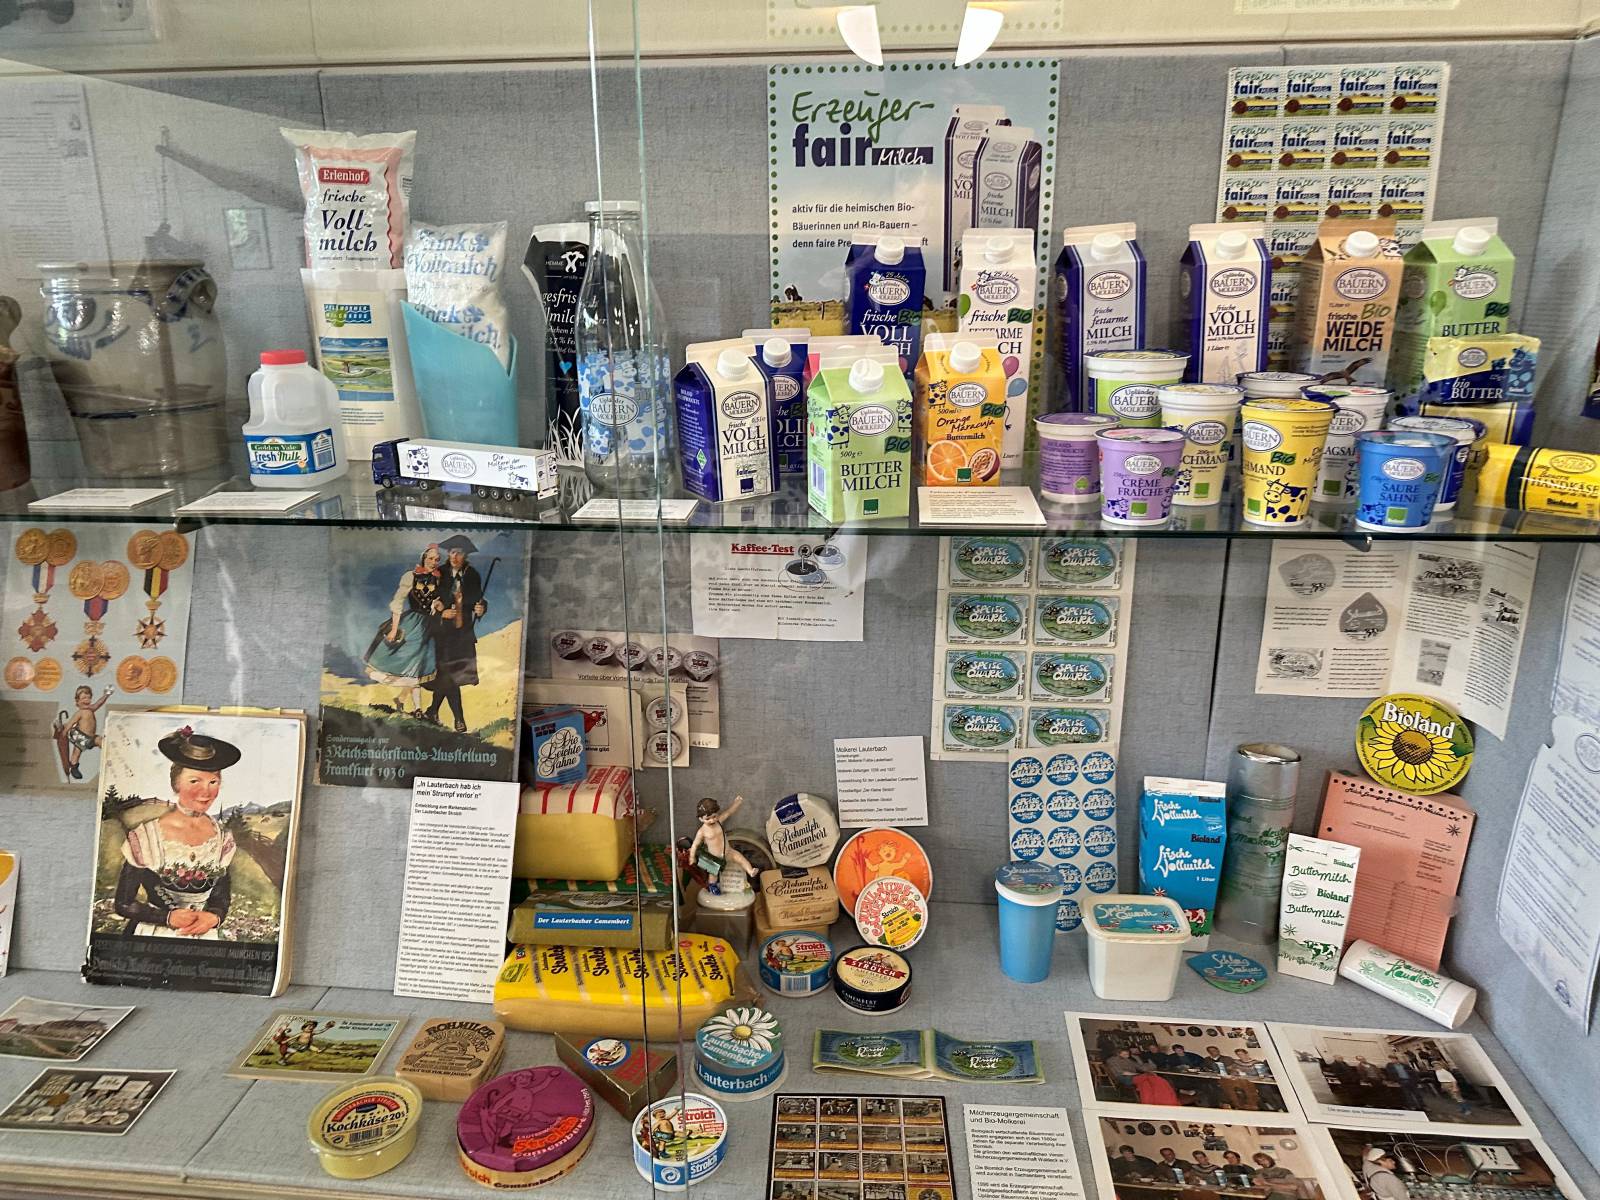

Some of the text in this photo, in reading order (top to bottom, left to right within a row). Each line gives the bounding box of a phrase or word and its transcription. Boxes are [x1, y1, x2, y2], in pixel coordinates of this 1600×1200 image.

[1234, 76, 1419, 95] fair fair fair fair
[792, 90, 935, 143] Erzeuger-
[792, 122, 926, 168] fair Milch
[323, 169, 365, 182] Erlenhof
[322, 188, 366, 205] frische
[792, 202, 915, 214] aktiv für die heimischen Bio-
[980, 207, 1014, 217] MILCH
[321, 209, 372, 230] Voll-
[792, 220, 841, 232] Bäuerinnen
[843, 220, 859, 230] und
[319, 231, 377, 252] milch
[792, 238, 835, 248] denn faire
[1090, 279, 1129, 290] BAUERN
[1213, 277, 1253, 288] BAUERN
[1339, 278, 1384, 289] BAUERN
[1455, 279, 1495, 289] BAUERN
[871, 286, 907, 296] BAUERN
[980, 286, 1015, 296] BAUERN
[1093, 306, 1113, 317] frische
[1216, 304, 1236, 313] frische
[1361, 303, 1391, 320] Bio
[862, 309, 921, 324] frische Bio
[969, 308, 1032, 325] frische Bio
[1091, 315, 1129, 328] fettarme
[1209, 310, 1255, 326] VOLL
[1328, 312, 1358, 321] frische
[860, 324, 912, 342] VOLL
[1086, 325, 1132, 341] MILCH
[1208, 323, 1255, 337] MILCH
[1326, 321, 1384, 338] WEIDE
[1441, 321, 1501, 338] BUTTER
[1322, 338, 1382, 352] MILCH
[1452, 377, 1470, 388] bio
[951, 390, 985, 400] BAUERN
[1451, 387, 1502, 399] BUTTER
[591, 403, 635, 415] BAUERN
[724, 400, 759, 411] BAUERN
[728, 421, 747, 430] frische
[851, 414, 892, 426] BAUERN
[937, 415, 971, 427] Orange
[951, 418, 995, 433] Maracuja
[722, 425, 766, 443] VOLL
[1189, 428, 1226, 438] BAUERN
[722, 439, 767, 456] MILCH
[254, 450, 300, 461] Fresh Milk
[492, 453, 504, 461] Die
[1182, 454, 1228, 465] CHMAND
[444, 460, 474, 470] BAUERN
[841, 460, 902, 477] BUTTER
[1125, 461, 1161, 469] BAUERN
[1384, 463, 1424, 472] BAUERN
[841, 474, 901, 491] MILCH
[1122, 475, 1161, 488] CRÈME
[1382, 482, 1420, 493] SAURE
[1117, 485, 1163, 497] FRAÎCHE
[1379, 492, 1420, 503] SAHNE
[731, 543, 794, 553] Kaffee-Test
[1383, 701, 1456, 739] Bioland
[555, 728, 579, 746] Die
[541, 742, 581, 760] Leichte
[378, 767, 405, 778] 1936
[427, 781, 459, 789] Lauterbach
[432, 790, 456, 798] Strumpf
[1152, 798, 1182, 820] frische
[1157, 809, 1202, 827] Vollmilch
[773, 817, 820, 842] Rohmilch
[778, 827, 828, 857] Camembert
[1191, 833, 1220, 843] Bioland
[1153, 844, 1192, 871] frische
[1157, 858, 1216, 878] Vollmilch
[766, 884, 829, 897] Camembert
[1317, 887, 1352, 903] Bioland
[881, 906, 899, 919] Strolch
[795, 943, 825, 951] Strolch
[851, 960, 896, 977] STROLCH
[425, 1021, 496, 1040] ROHMILCH
[702, 1034, 765, 1059] Lauterbacher
[701, 1041, 758, 1066] Camembert
[699, 1065, 767, 1089] Lauterbach
[969, 1109, 1060, 1119] Milcherzeugergemeinschaft
[326, 1115, 389, 1133] Kochkäse
[984, 1117, 1026, 1125] Bio-Molkerei
[512, 1117, 587, 1158] Camembert
[690, 1155, 717, 1174] Strolch
[493, 1170, 564, 1189] Camembert
